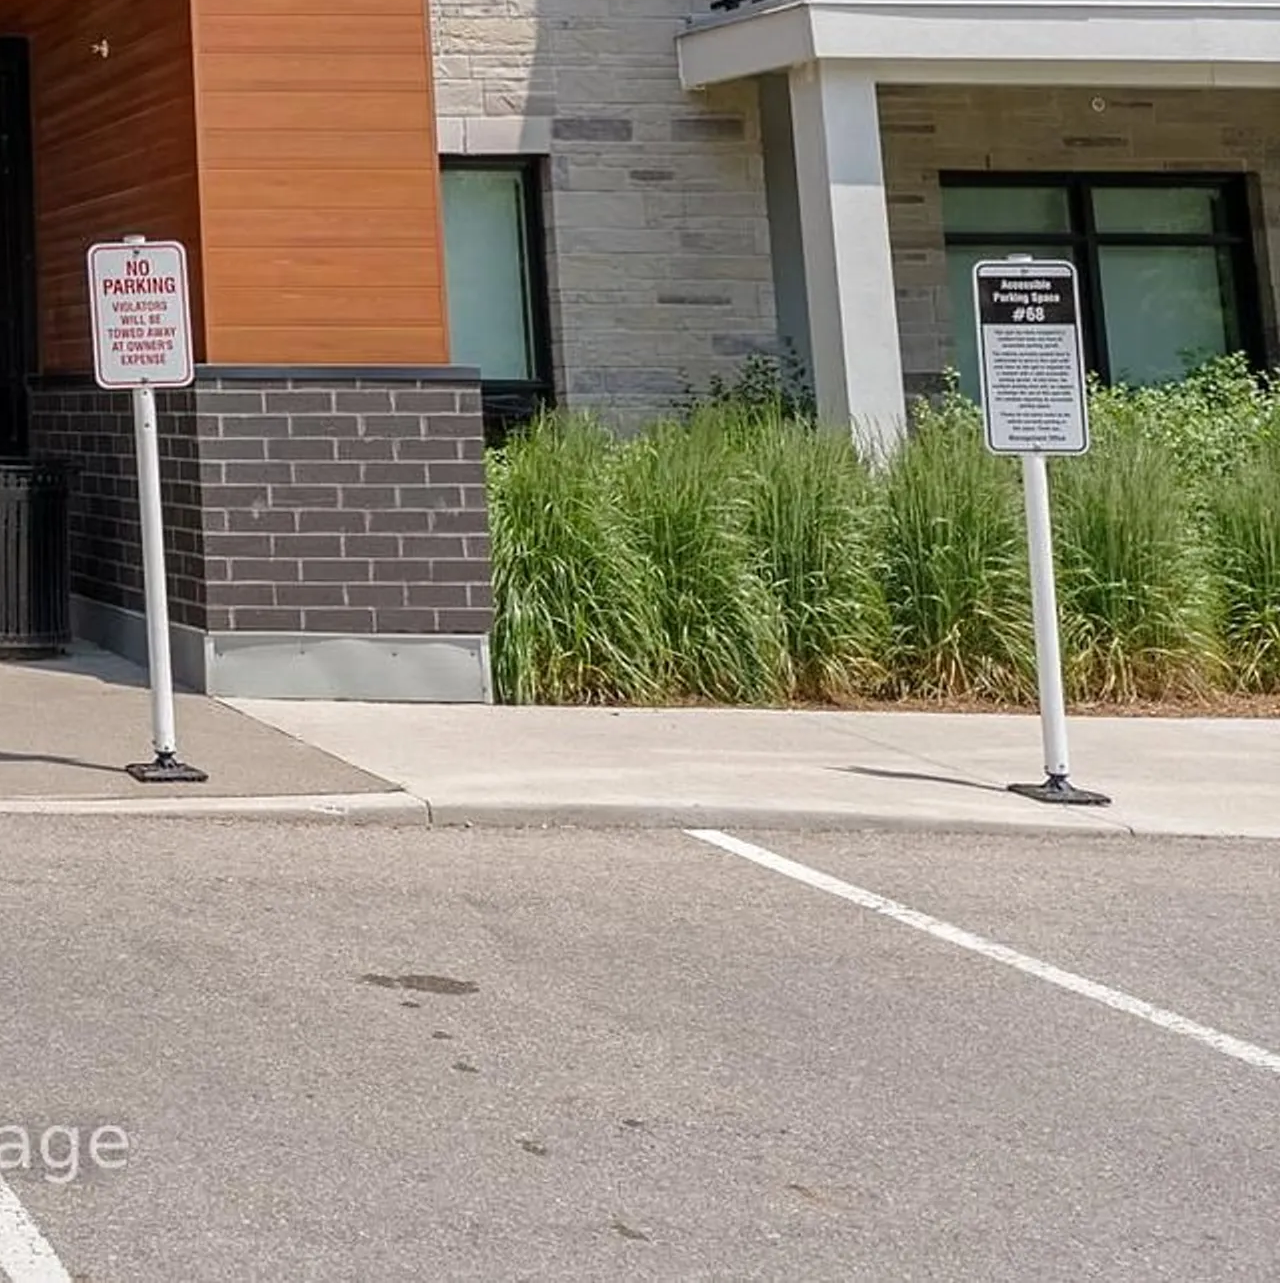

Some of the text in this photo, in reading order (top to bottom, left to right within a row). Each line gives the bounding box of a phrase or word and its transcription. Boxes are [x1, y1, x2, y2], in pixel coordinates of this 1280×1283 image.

[126, 260, 150, 276] NO
[103, 277, 176, 296] PARKING
[1001, 279, 1051, 291] Accessible
[993, 292, 1060, 305] Parking Space
[112, 301, 167, 313] VIOLATORS
[121, 314, 161, 326] WILL BE
[1012, 306, 1044, 322] #68
[108, 327, 176, 340] TOWED AWAY
[112, 342, 124, 352] AT
[121, 354, 165, 366] EXPENSE
